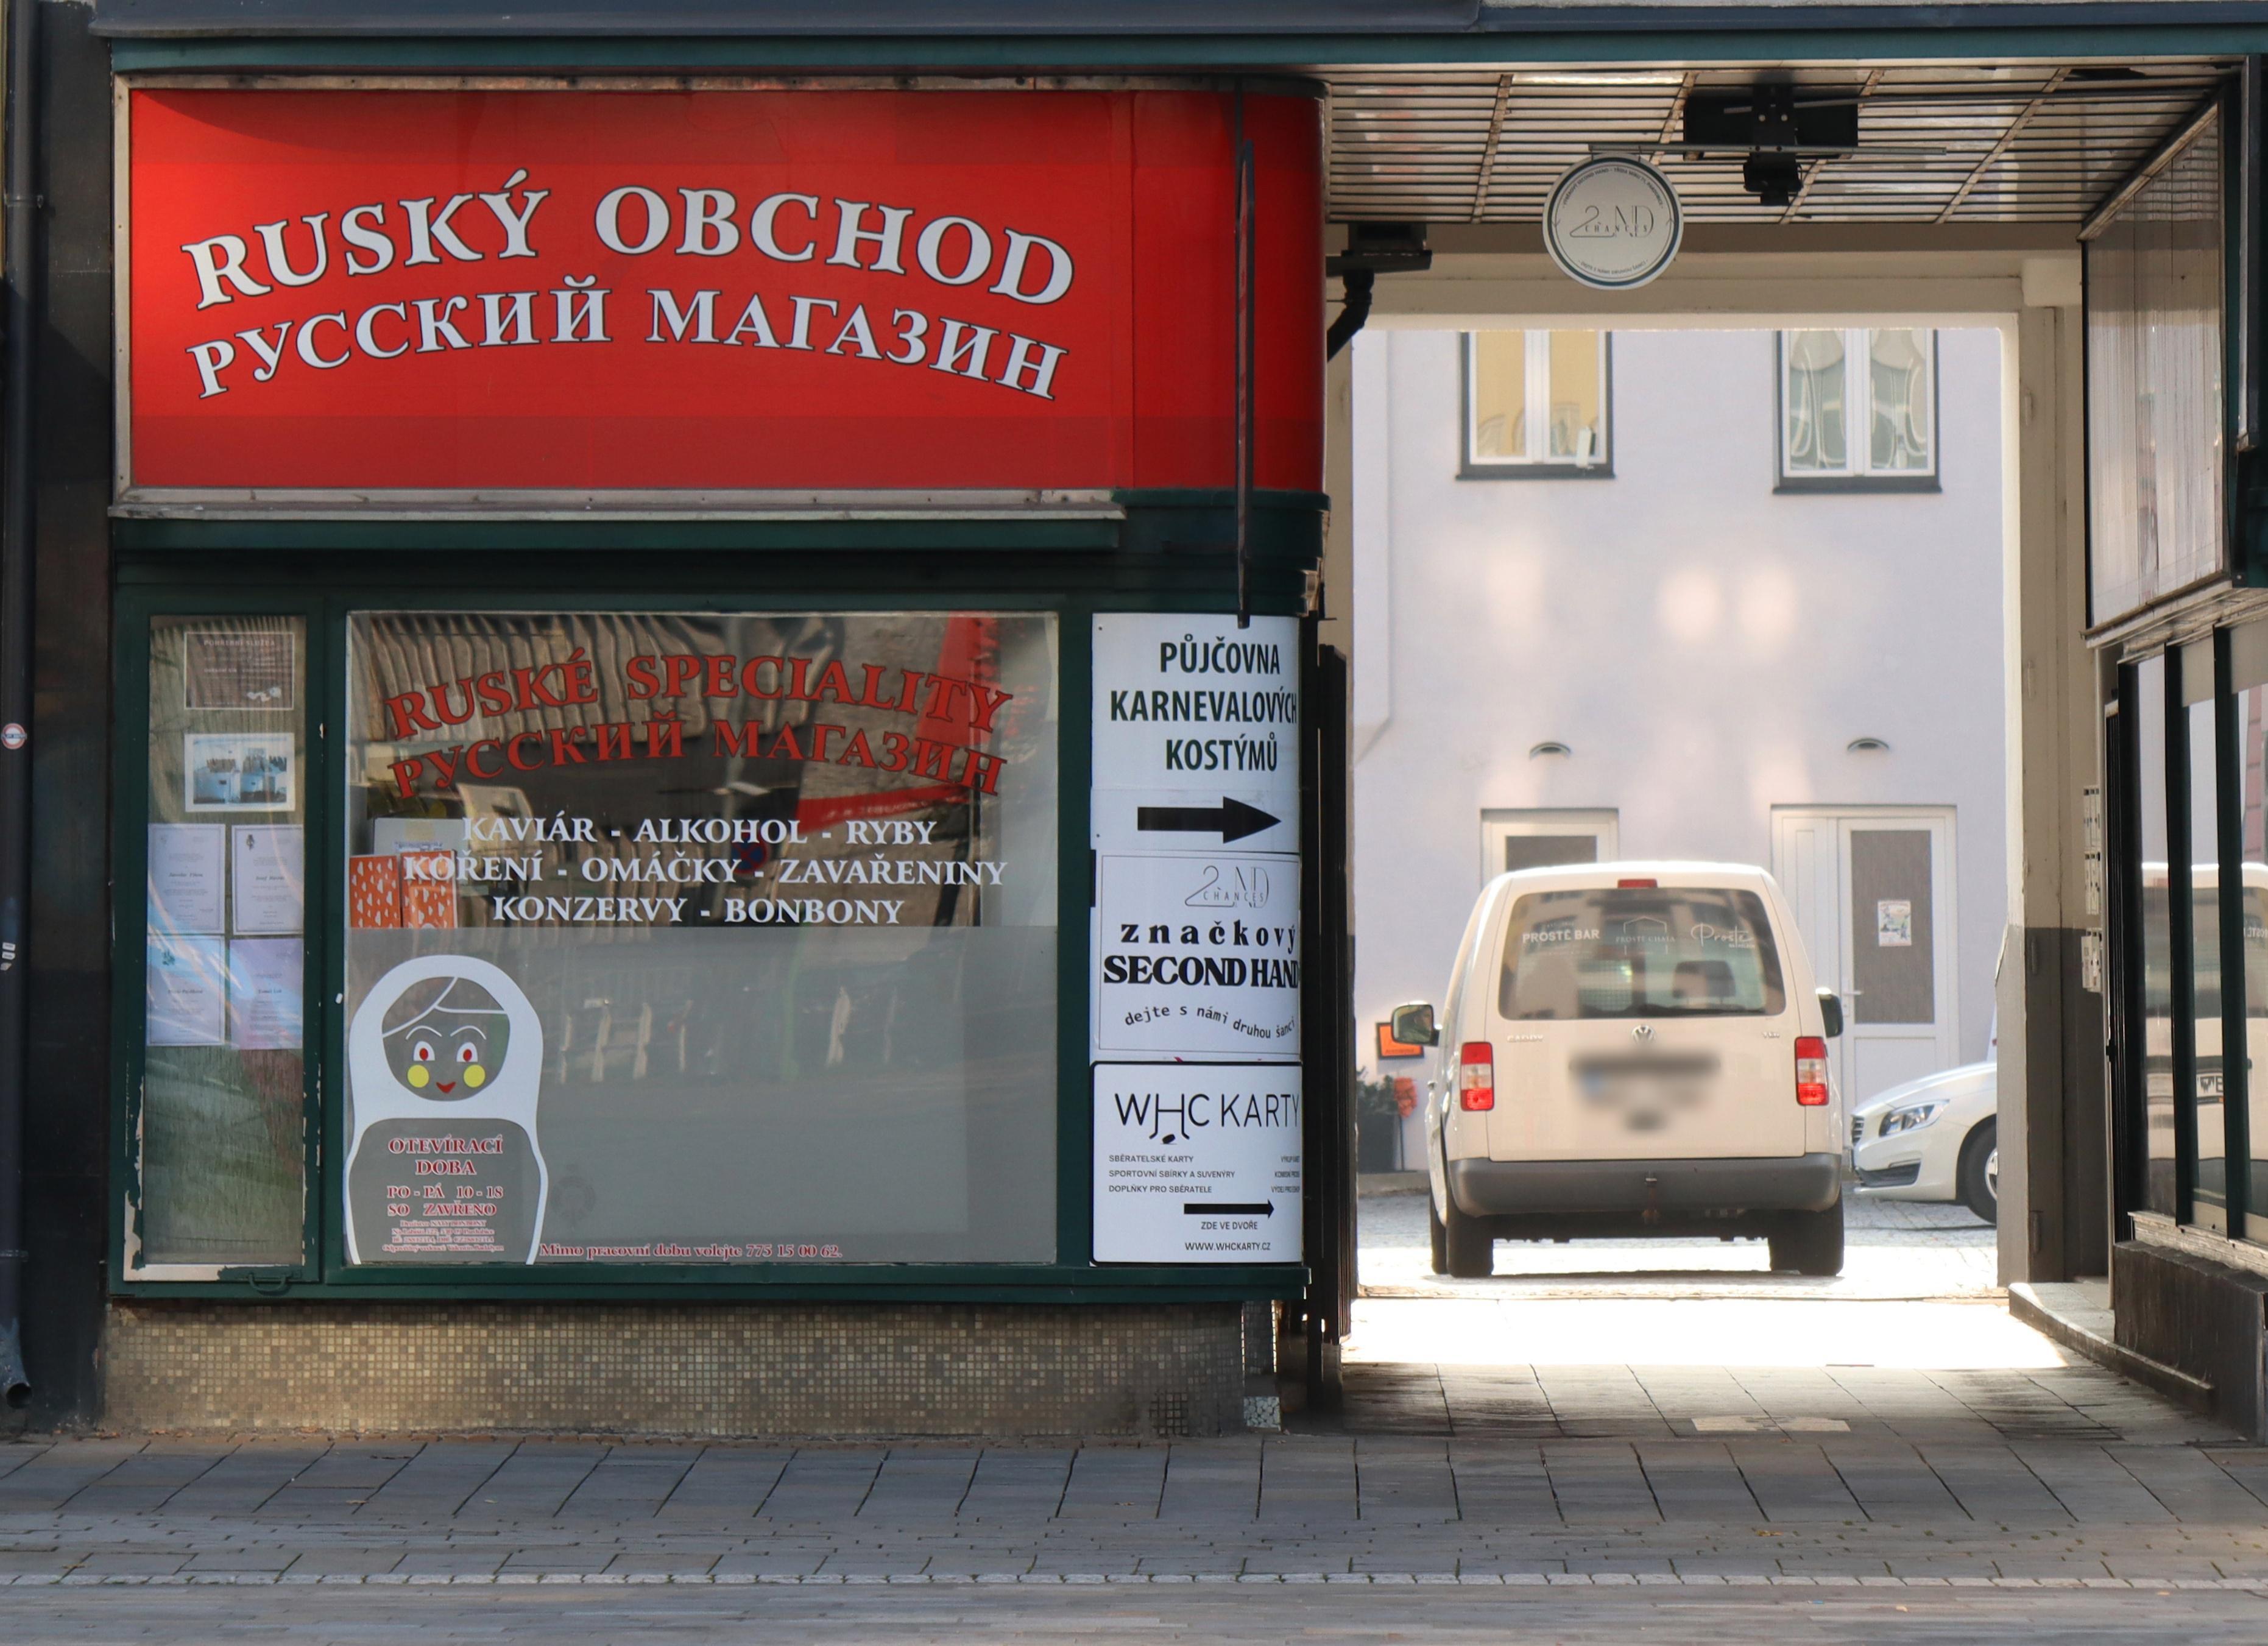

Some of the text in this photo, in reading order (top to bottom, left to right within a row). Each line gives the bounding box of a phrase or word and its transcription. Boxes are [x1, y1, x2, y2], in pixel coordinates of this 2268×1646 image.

[180, 168, 1075, 311] RUSKÝ OBCHOD
[185, 274, 1069, 401] РУССКИЙ МАГАЗИН
[1160, 634, 1280, 674] PŮJČOVNA
[385, 646, 1012, 741] RUSKÉ SPECIALITY
[1111, 686, 1296, 724] KARNEVALOVÝCH
[387, 710, 1007, 799] РУССКИЙ МАГАЗИН
[1166, 732, 1277, 771] KOSTÝMŮ
[462, 811, 598, 842] KAVIÁR
[634, 818, 807, 844] ALKOHOL
[846, 819, 937, 845] RYBY
[403, 850, 542, 882] KOŘENÍ
[582, 850, 741, 883] OMÁČKY
[779, 853, 1008, 885] ZAVAŘENINY
[493, 895, 687, 922] KONZERVY
[724, 899, 905, 924] BONBONY
[1203, 892, 1263, 902] CHANCES
[1121, 919, 1296, 954] značkový
[1574, 928, 1600, 940] BAR
[1104, 955, 1299, 988] SECOND HAND
[1125, 1006, 1296, 1039] dejte s námi druhou šanci
[1115, 1093, 1300, 1140] WHC KARTY
[388, 1134, 503, 1154] OTEVÍRACÍ
[1109, 1154, 1166, 1163] SBĚRATELSKÉ
[415, 1159, 476, 1176] DOBA
[1109, 1169, 1157, 1178] SPORTOVNÍ
[387, 1185, 410, 1199] PO
[424, 1182, 445, 1199] PÁ
[456, 1185, 473, 1199] 10
[486, 1185, 503, 1199] 18
[1169, 1185, 1212, 1193] SBĚRATELE
[387, 1199, 497, 1217] SO ZAVŘENO
[1232, 1219, 1258, 1229] DVOŘE
[540, 1242, 843, 1261] Mimo pracovní dobu volejte 775 15 00 62.
[1185, 1242, 1271, 1251] WWW.WHCKARTY.CZ
